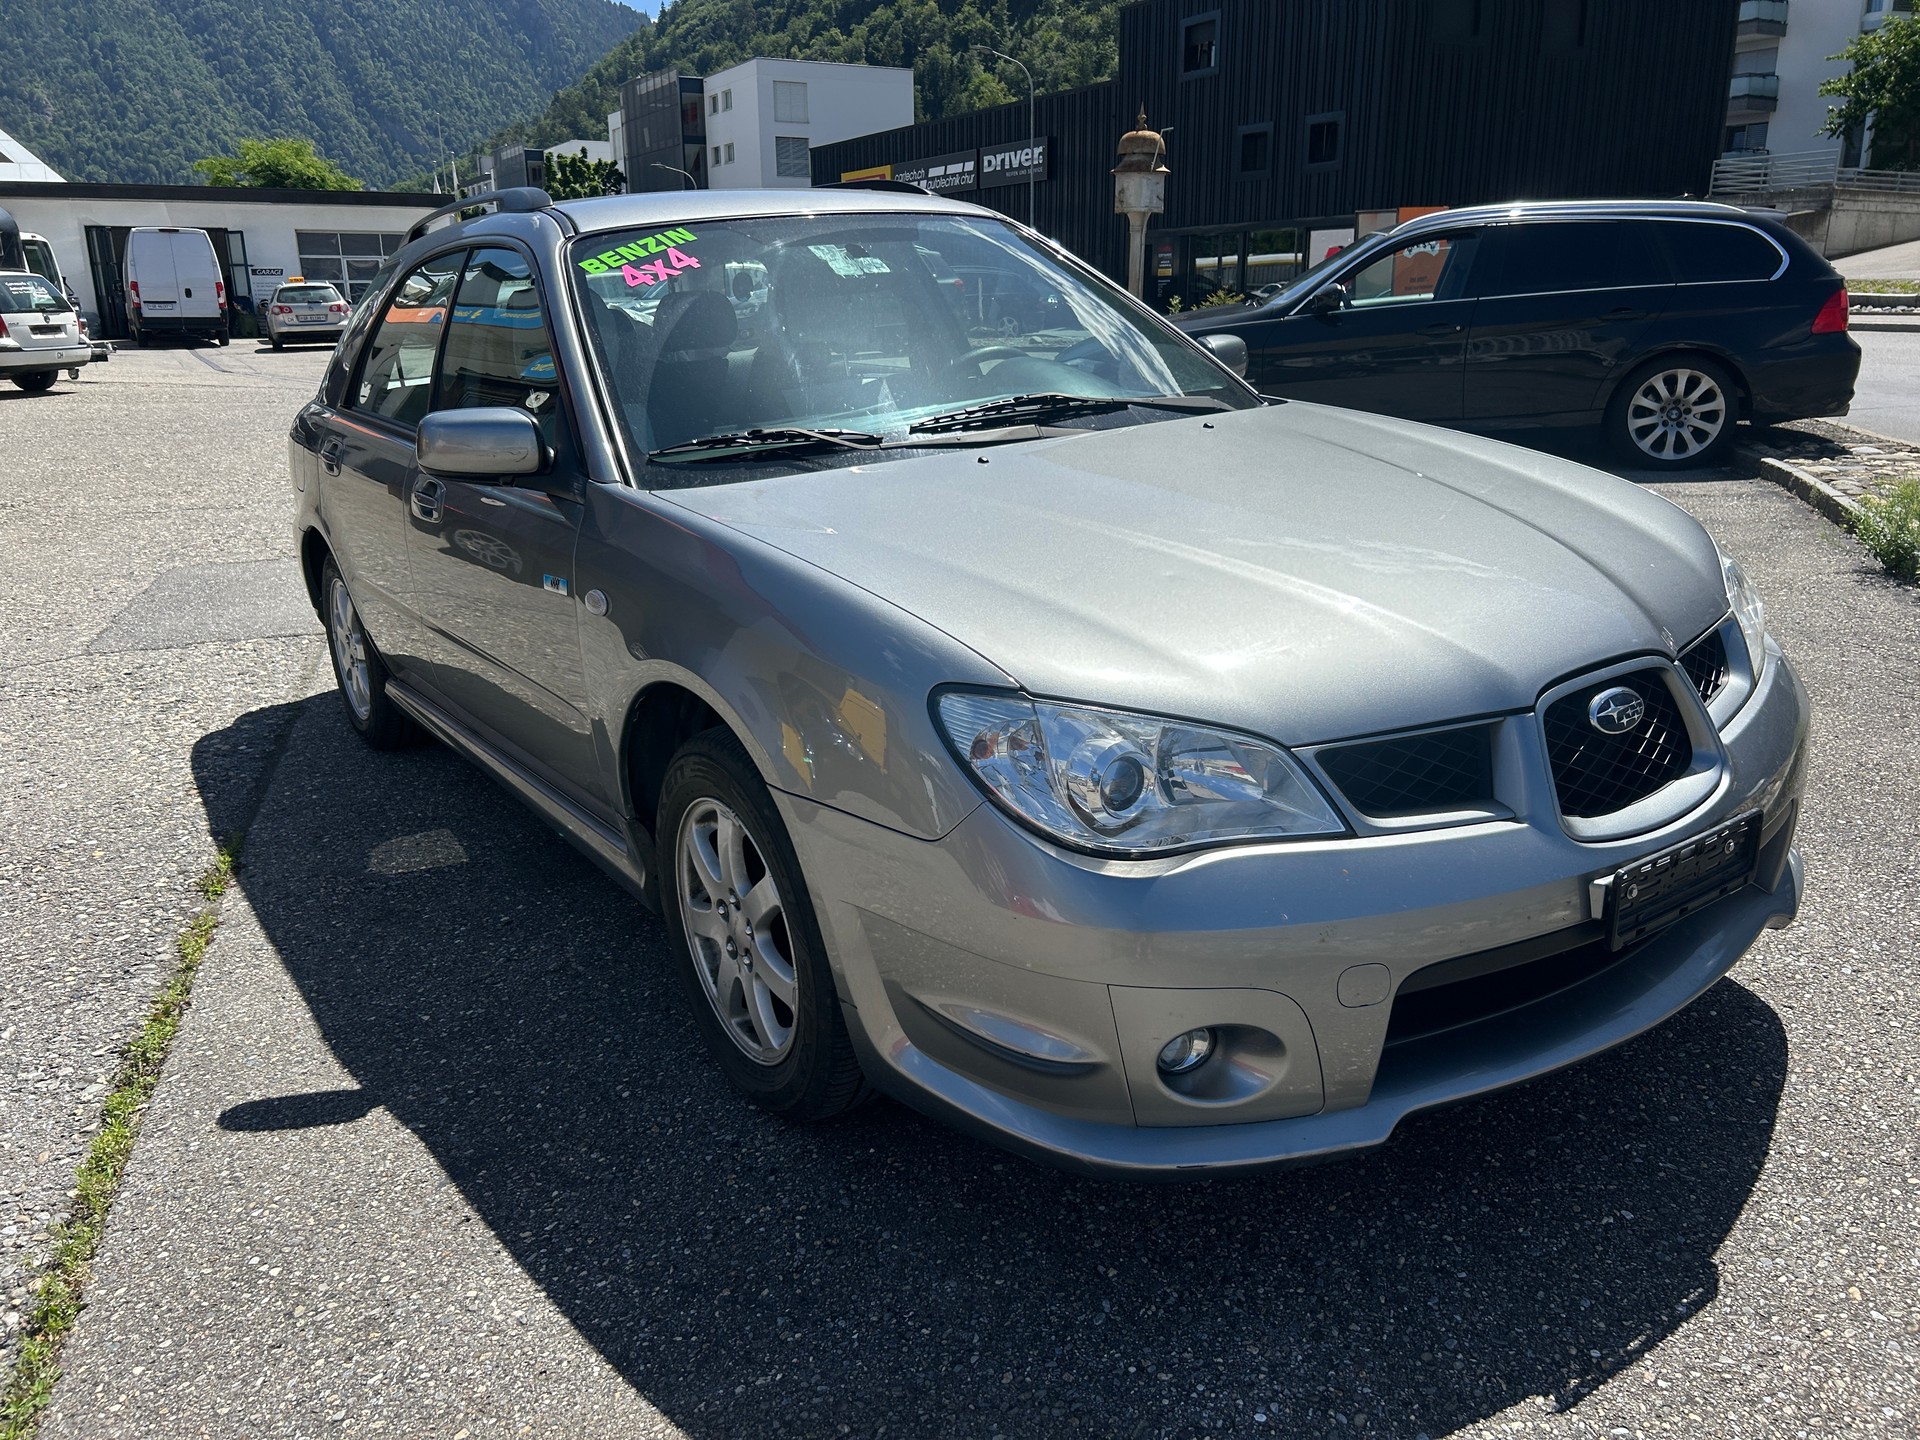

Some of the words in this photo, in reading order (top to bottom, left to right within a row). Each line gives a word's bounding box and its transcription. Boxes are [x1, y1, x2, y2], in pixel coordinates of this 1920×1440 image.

[927, 174, 960, 190] autotechnik
[960, 172, 975, 185] chur
[578, 227, 698, 274] BENZIN
